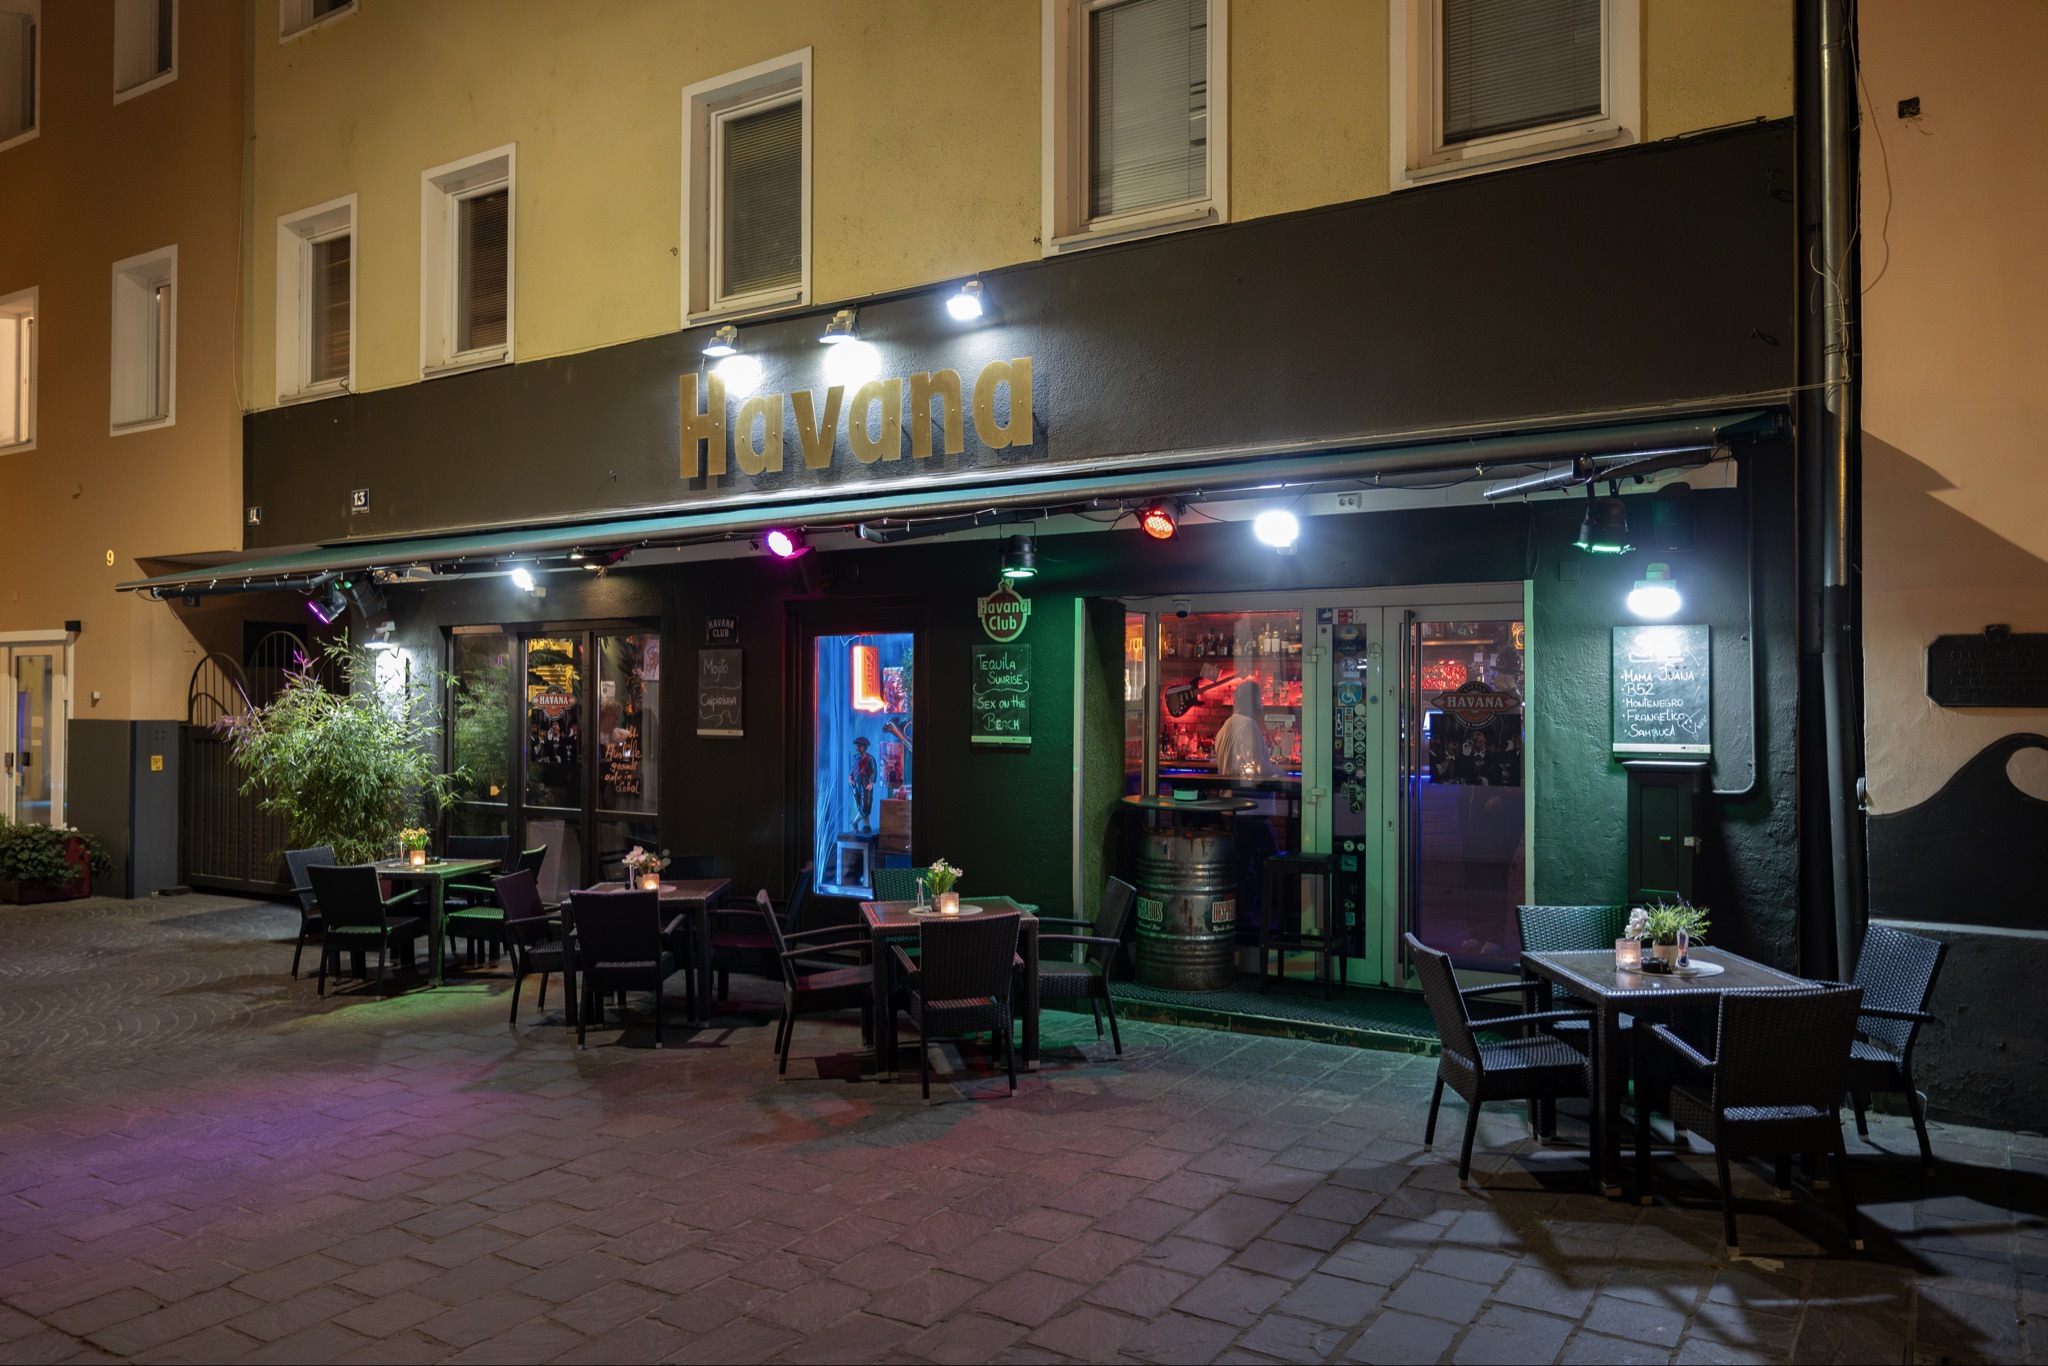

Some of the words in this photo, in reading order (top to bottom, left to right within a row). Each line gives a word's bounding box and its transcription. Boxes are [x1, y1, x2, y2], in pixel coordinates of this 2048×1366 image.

[680, 356, 1033, 479] Havana
[354, 491, 366, 506] 13
[106, 549, 115, 567] 9
[979, 600, 1029, 615] Havana
[708, 619, 735, 630] HAVANA
[988, 615, 1018, 631] Club
[712, 628, 730, 638] CLUB
[703, 657, 729, 682] Mojito
[1624, 669, 1653, 682] MAMA
[1622, 682, 1656, 697] B52
[539, 696, 569, 705] HAVANA
[1446, 696, 1504, 708] HAVANA
